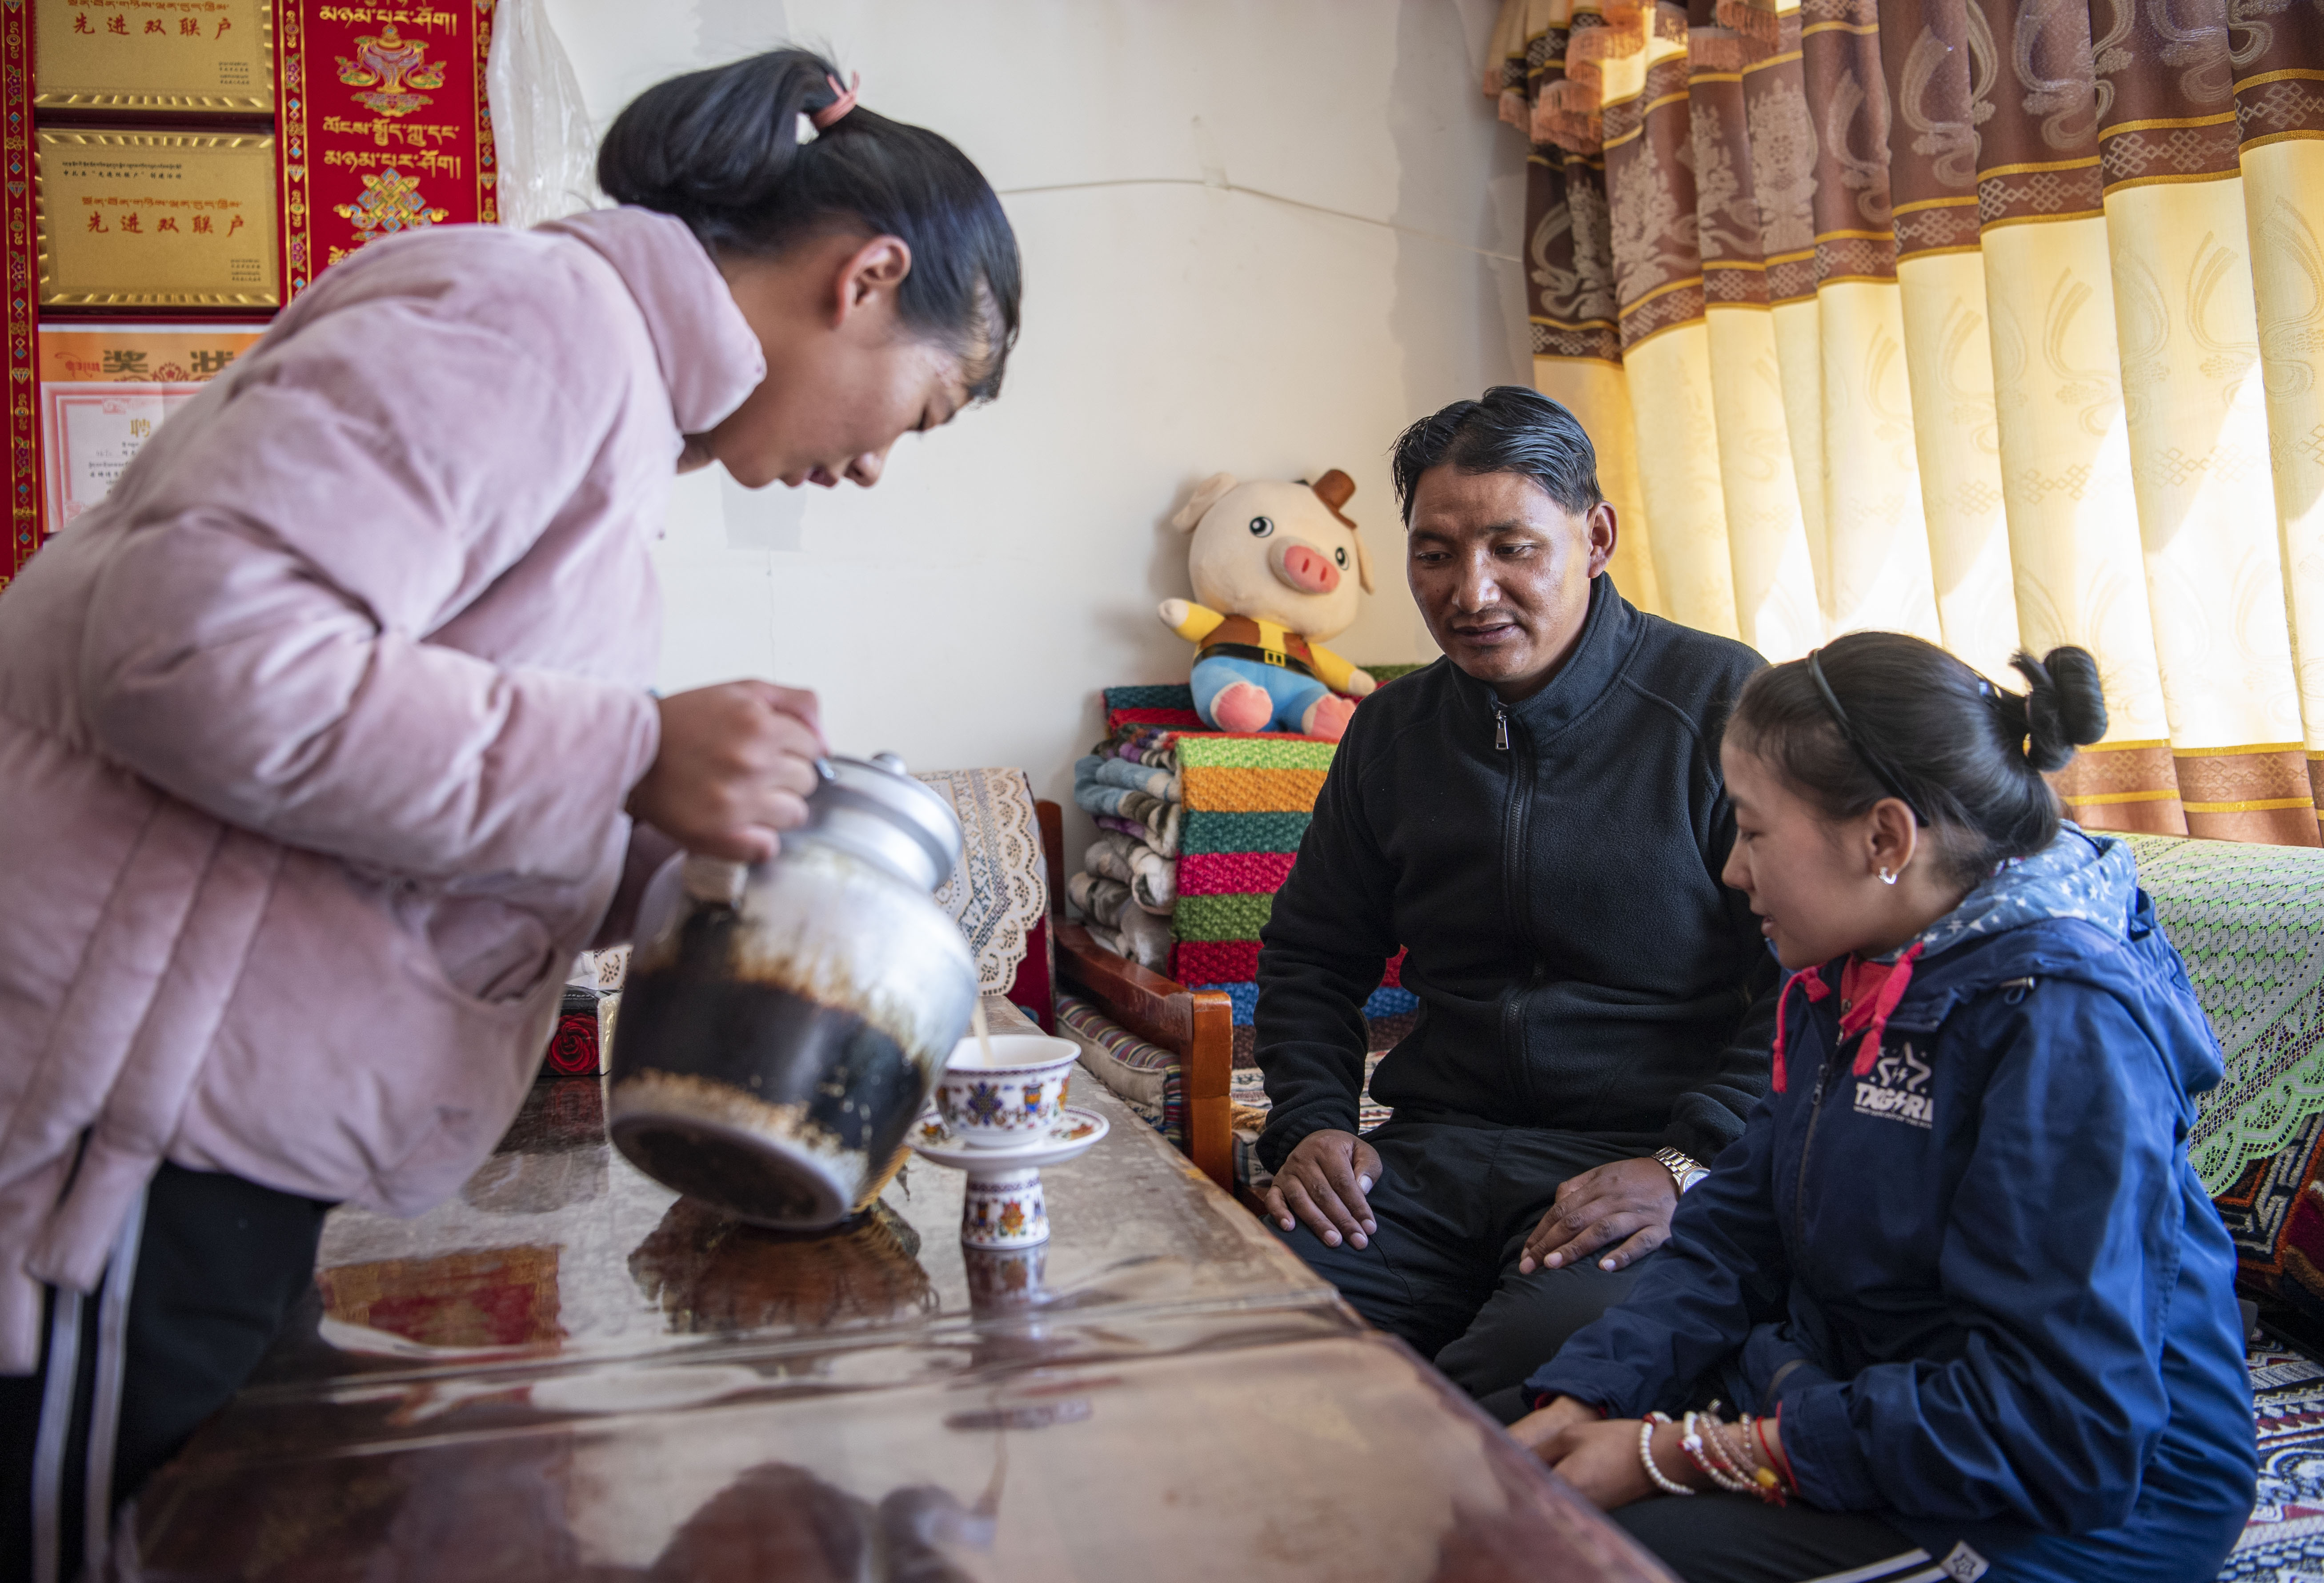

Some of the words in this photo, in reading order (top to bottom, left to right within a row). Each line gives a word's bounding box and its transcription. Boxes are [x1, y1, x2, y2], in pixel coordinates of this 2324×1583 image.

[73, 12, 232, 40] 先进双联户
[88, 211, 244, 237] 先进双联户
[103, 350, 234, 373] 奖状
